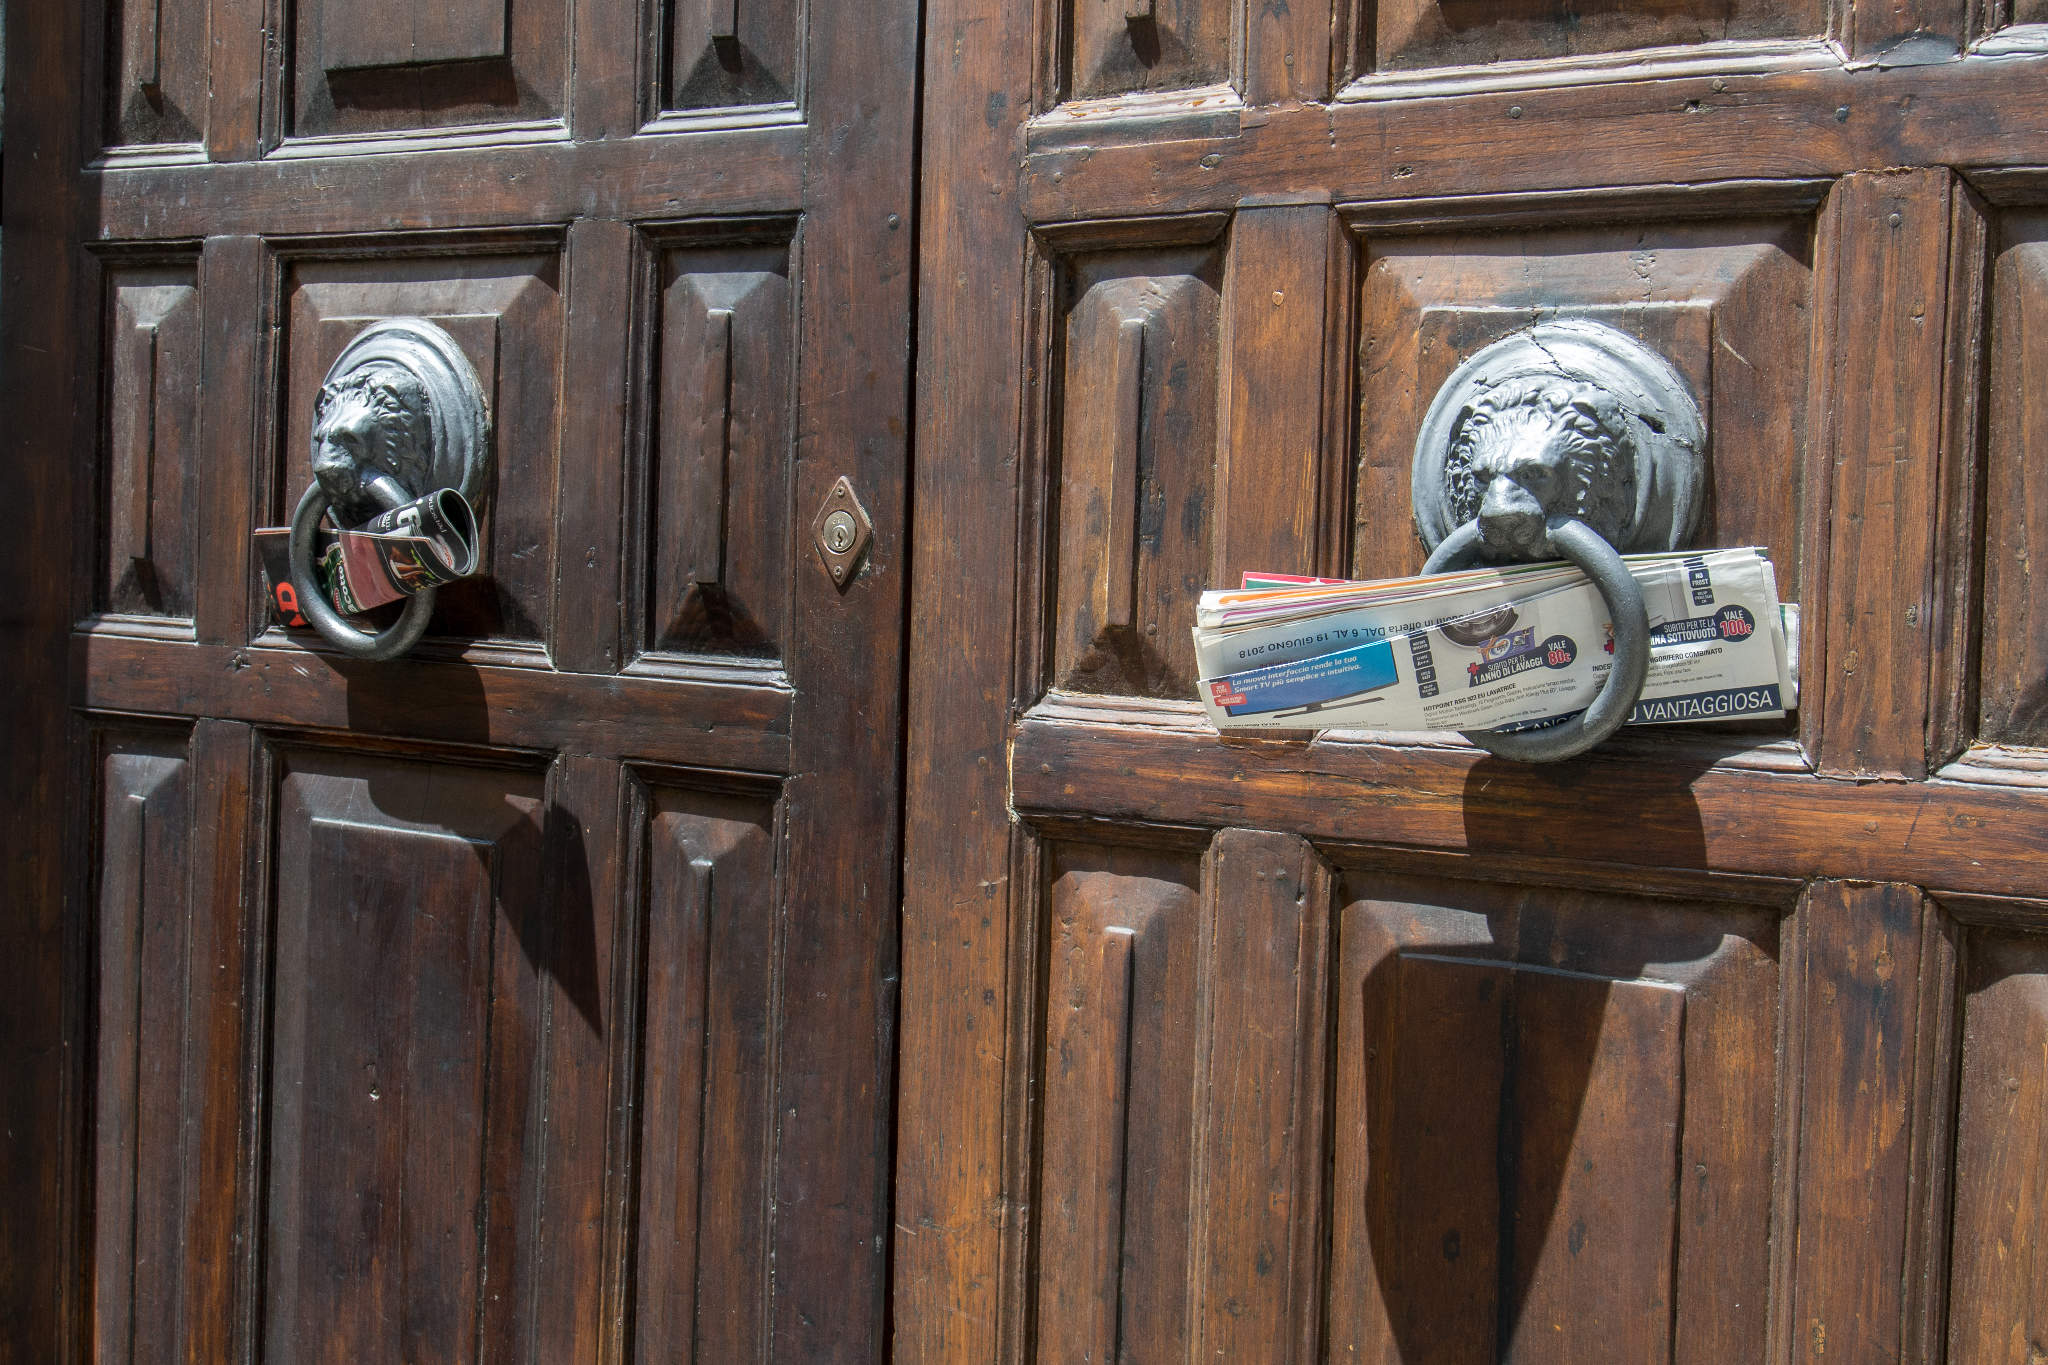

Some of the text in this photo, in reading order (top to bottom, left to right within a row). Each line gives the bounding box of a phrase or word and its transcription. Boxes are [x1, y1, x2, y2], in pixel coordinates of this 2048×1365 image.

[1724, 610, 1744, 620] VALE
[1388, 622, 1420, 633] offerta
[1663, 618, 1716, 633] SUBITO PER TE LA
[1720, 618, 1752, 637] 100€
[1316, 632, 1329, 642] 19
[1333, 629, 1349, 639] AL
[1353, 629, 1359, 638] 6
[1361, 627, 1385, 638] DAL
[1667, 628, 1717, 643] SOTTOVUOTO
[1267, 636, 1313, 652] GIUGNO
[1548, 640, 1566, 651] VALE
[1239, 645, 1265, 659] 2018
[1548, 649, 1571, 666] 80€
[1684, 647, 1723, 659] COMBINATO
[1311, 661, 1333, 671] rende
[1508, 657, 1519, 667] PER
[1519, 655, 1526, 664] TE
[1480, 669, 1501, 683] ANNO
[1502, 667, 1511, 676] DI
[1511, 657, 1544, 673] LAVAGGI
[1234, 682, 1258, 693] Smart
[1260, 680, 1271, 689] TV
[1285, 672, 1319, 685] semplice
[1486, 683, 1516, 697] LAVATRICE
[1642, 690, 1773, 720] VANTAGGIOSA
